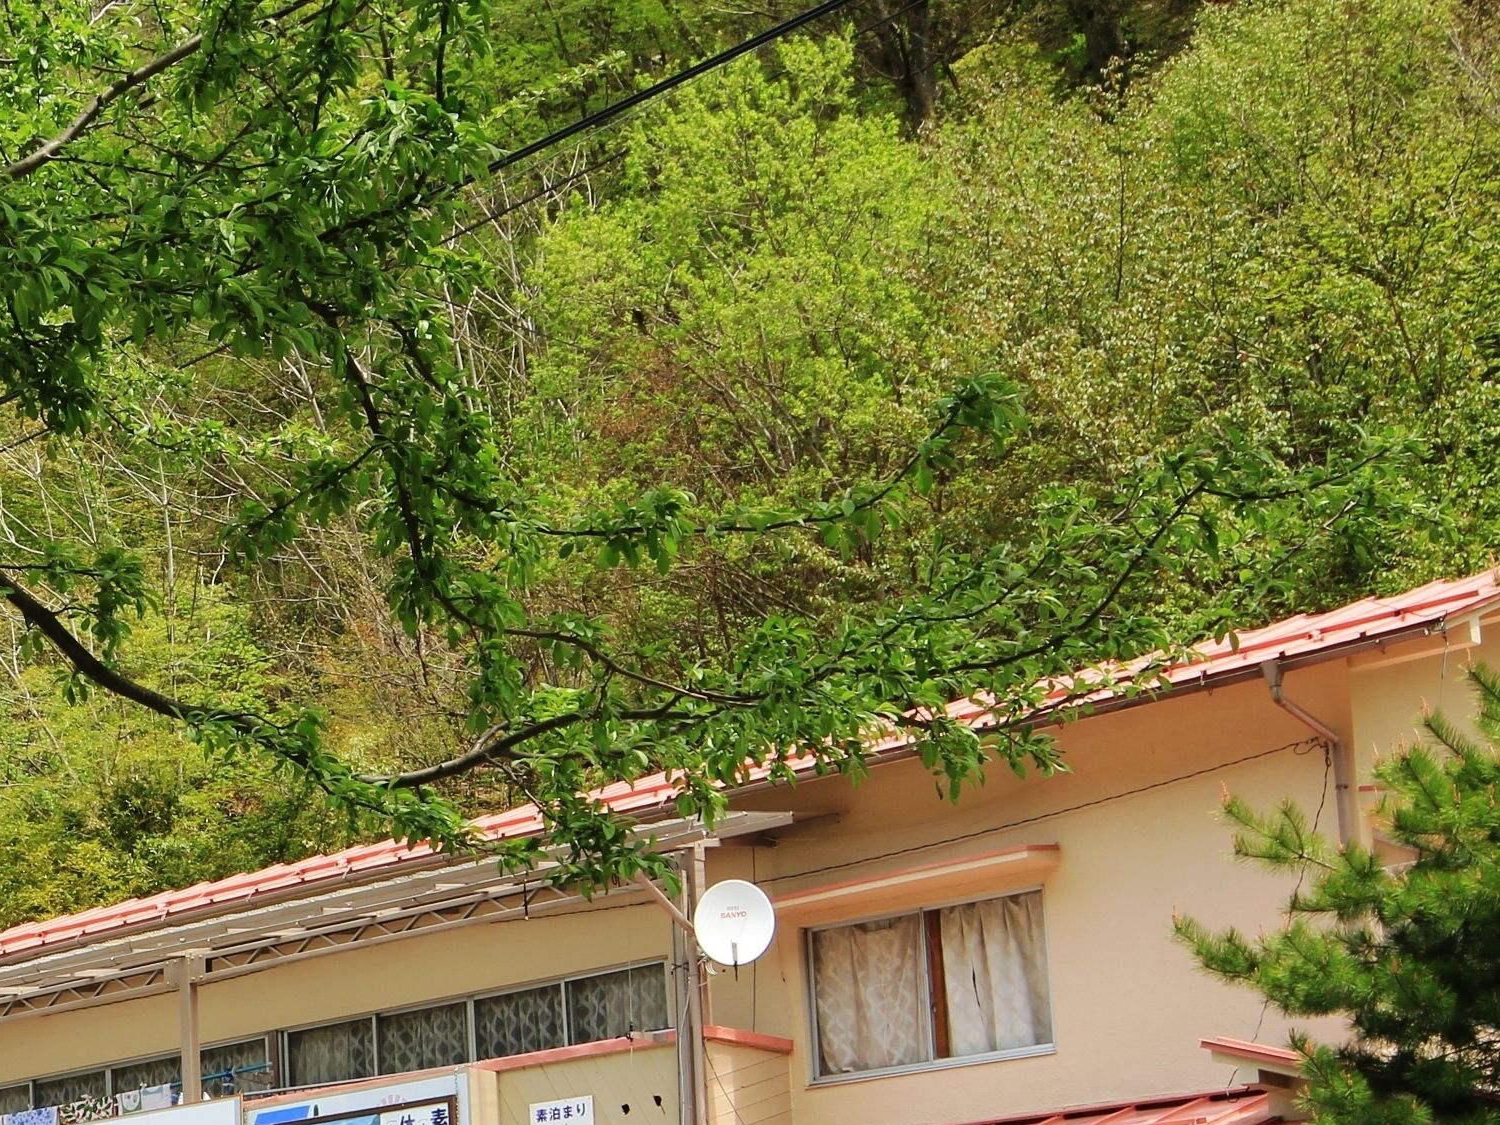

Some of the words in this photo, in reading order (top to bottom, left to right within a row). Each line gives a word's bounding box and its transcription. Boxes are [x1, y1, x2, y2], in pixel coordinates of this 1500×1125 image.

[721, 911, 747, 919] SANYO
[536, 1103, 587, 1123] 素泊まり
